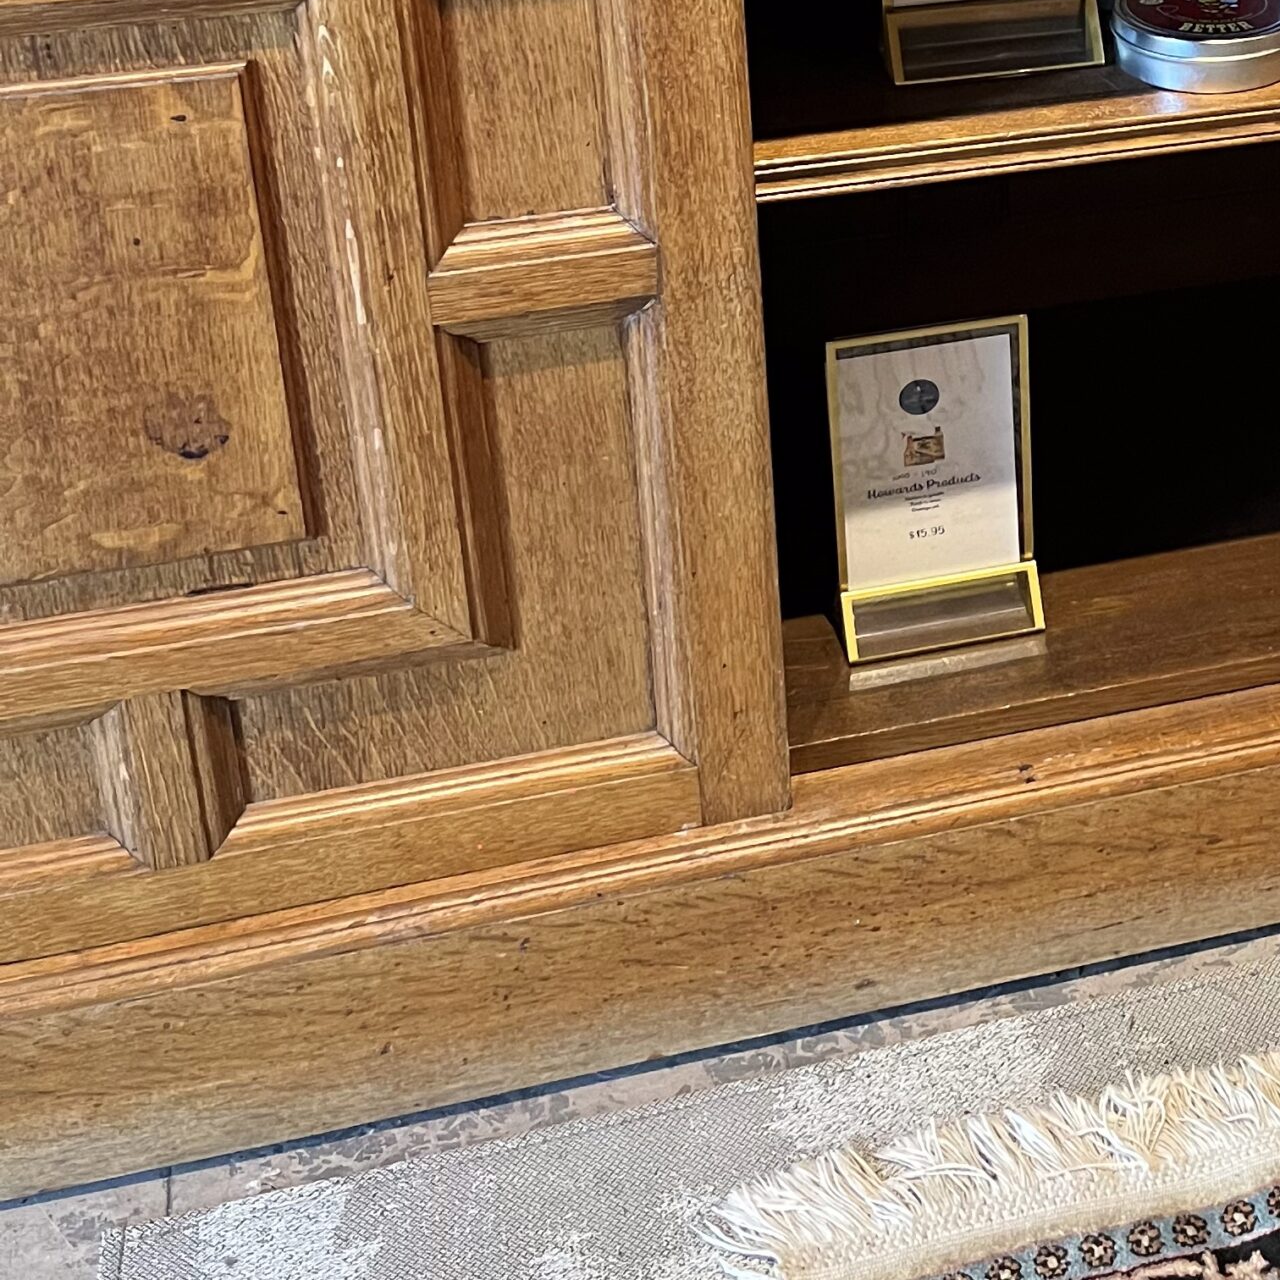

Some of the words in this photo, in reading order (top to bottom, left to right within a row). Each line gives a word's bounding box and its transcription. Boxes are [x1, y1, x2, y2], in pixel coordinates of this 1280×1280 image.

[1178, 20, 1255, 34] BETTER
[867, 482, 924, 500] Howards
[926, 472, 982, 491] Products
